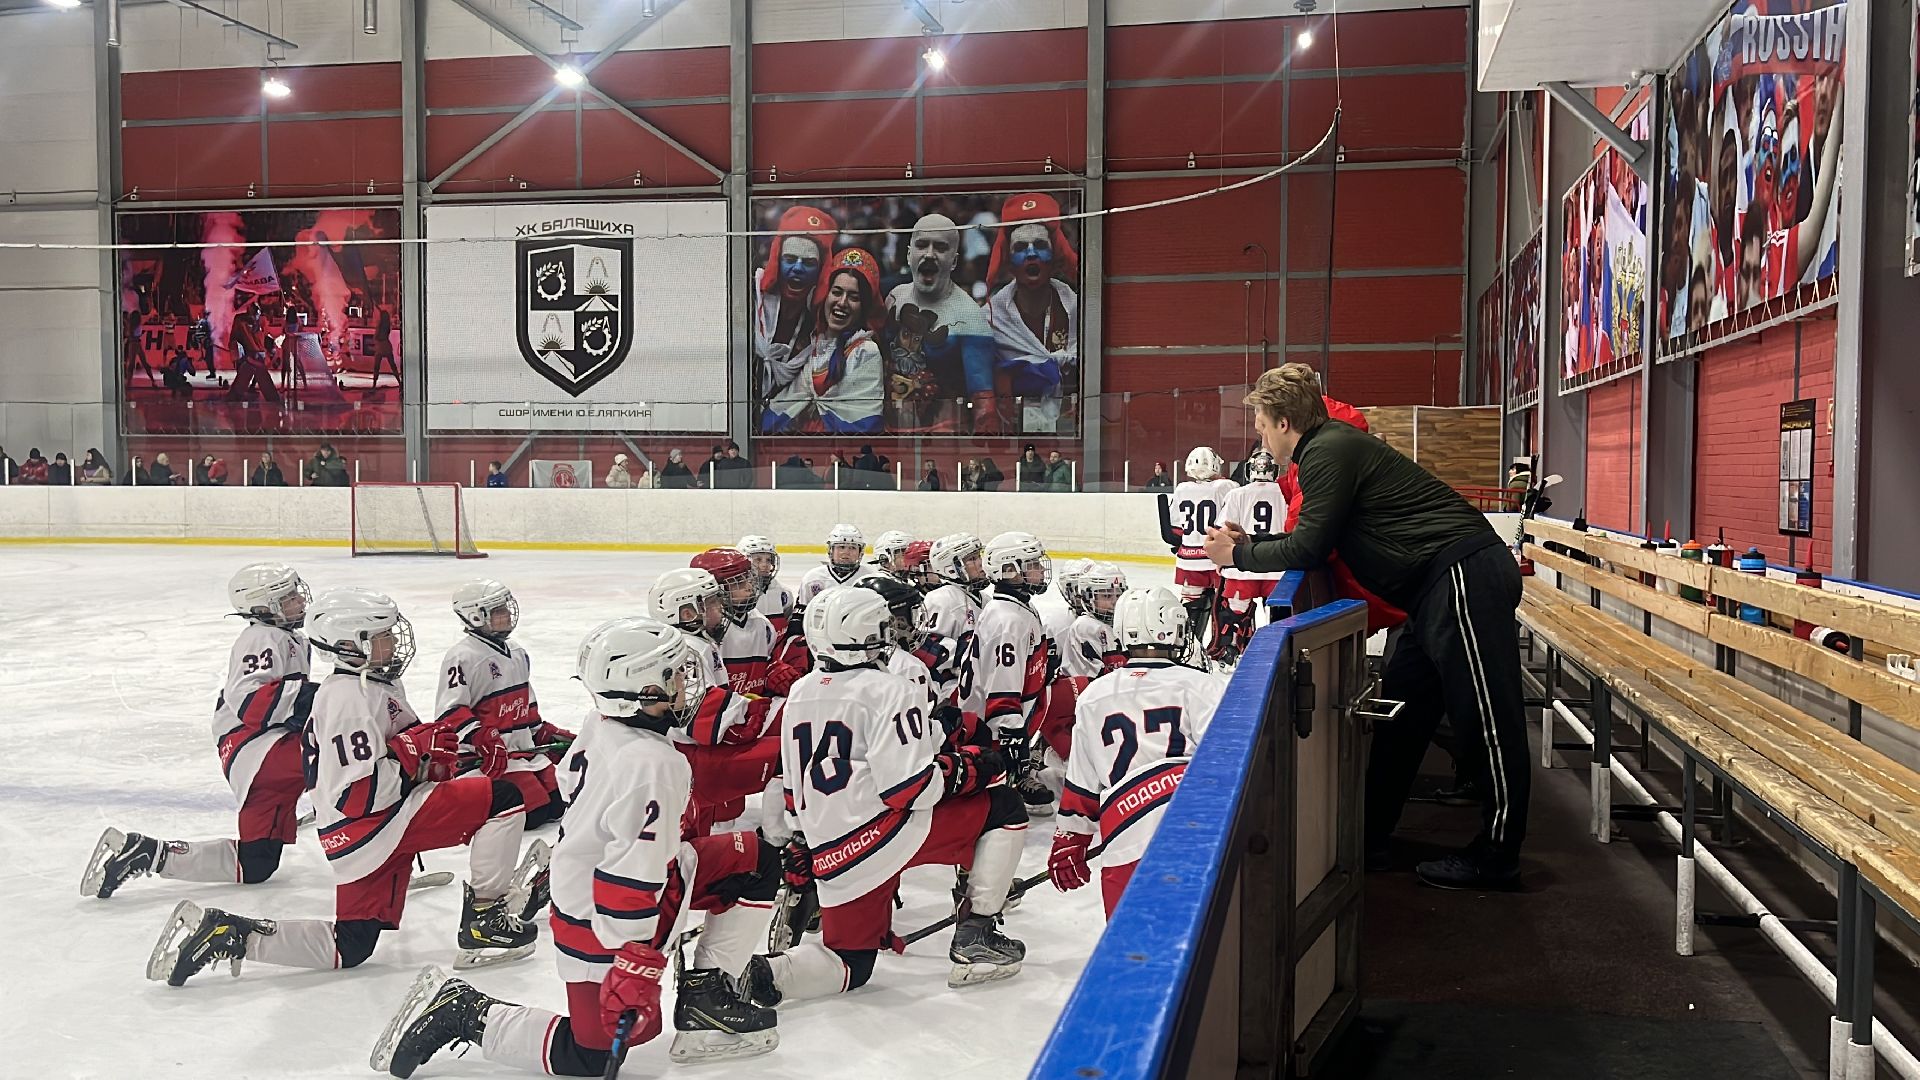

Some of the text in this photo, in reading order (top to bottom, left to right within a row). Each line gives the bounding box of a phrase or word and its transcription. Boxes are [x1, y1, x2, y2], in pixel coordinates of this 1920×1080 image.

[515, 217, 634, 237] ХК БАЛАШИХА
[499, 409, 530, 417] СШОР
[532, 409, 573, 417] ИМЕНИ
[1178, 499, 1217, 535] 30
[1252, 500, 1273, 534] 9
[242, 648, 273, 675] 33
[892, 706, 922, 746] 10
[999, 737, 1024, 746] CM
[331, 730, 373, 767] 18
[1101, 705, 1187, 788] 27
[792, 720, 854, 811] 10
[1116, 771, 1185, 816] ПОДОЛЬ
[637, 799, 660, 842] 2
